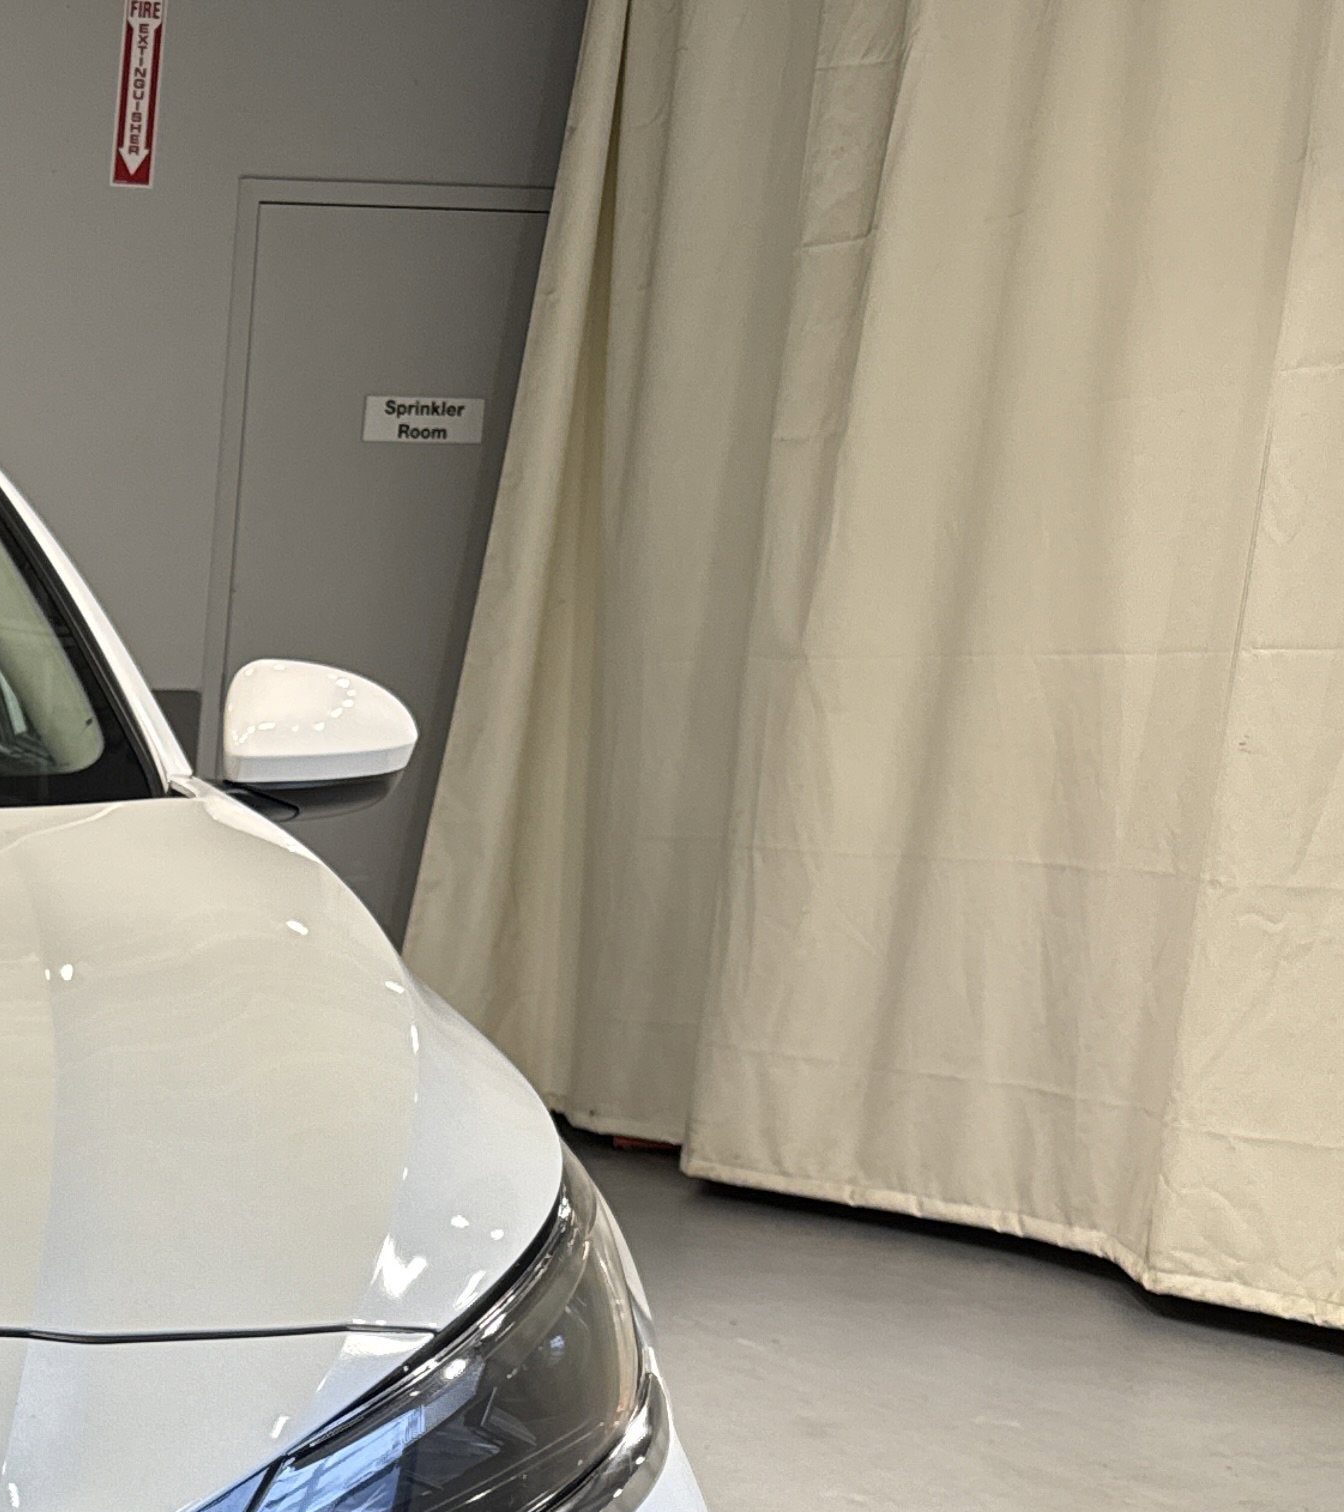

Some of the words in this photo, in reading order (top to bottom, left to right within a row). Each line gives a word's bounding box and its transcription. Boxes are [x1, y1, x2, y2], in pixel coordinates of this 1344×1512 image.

[130, 1, 161, 18] FIRE
[128, 24, 150, 155] EXTINGUISHER
[385, 400, 465, 418] Sprinkler
[398, 424, 447, 439] Room
